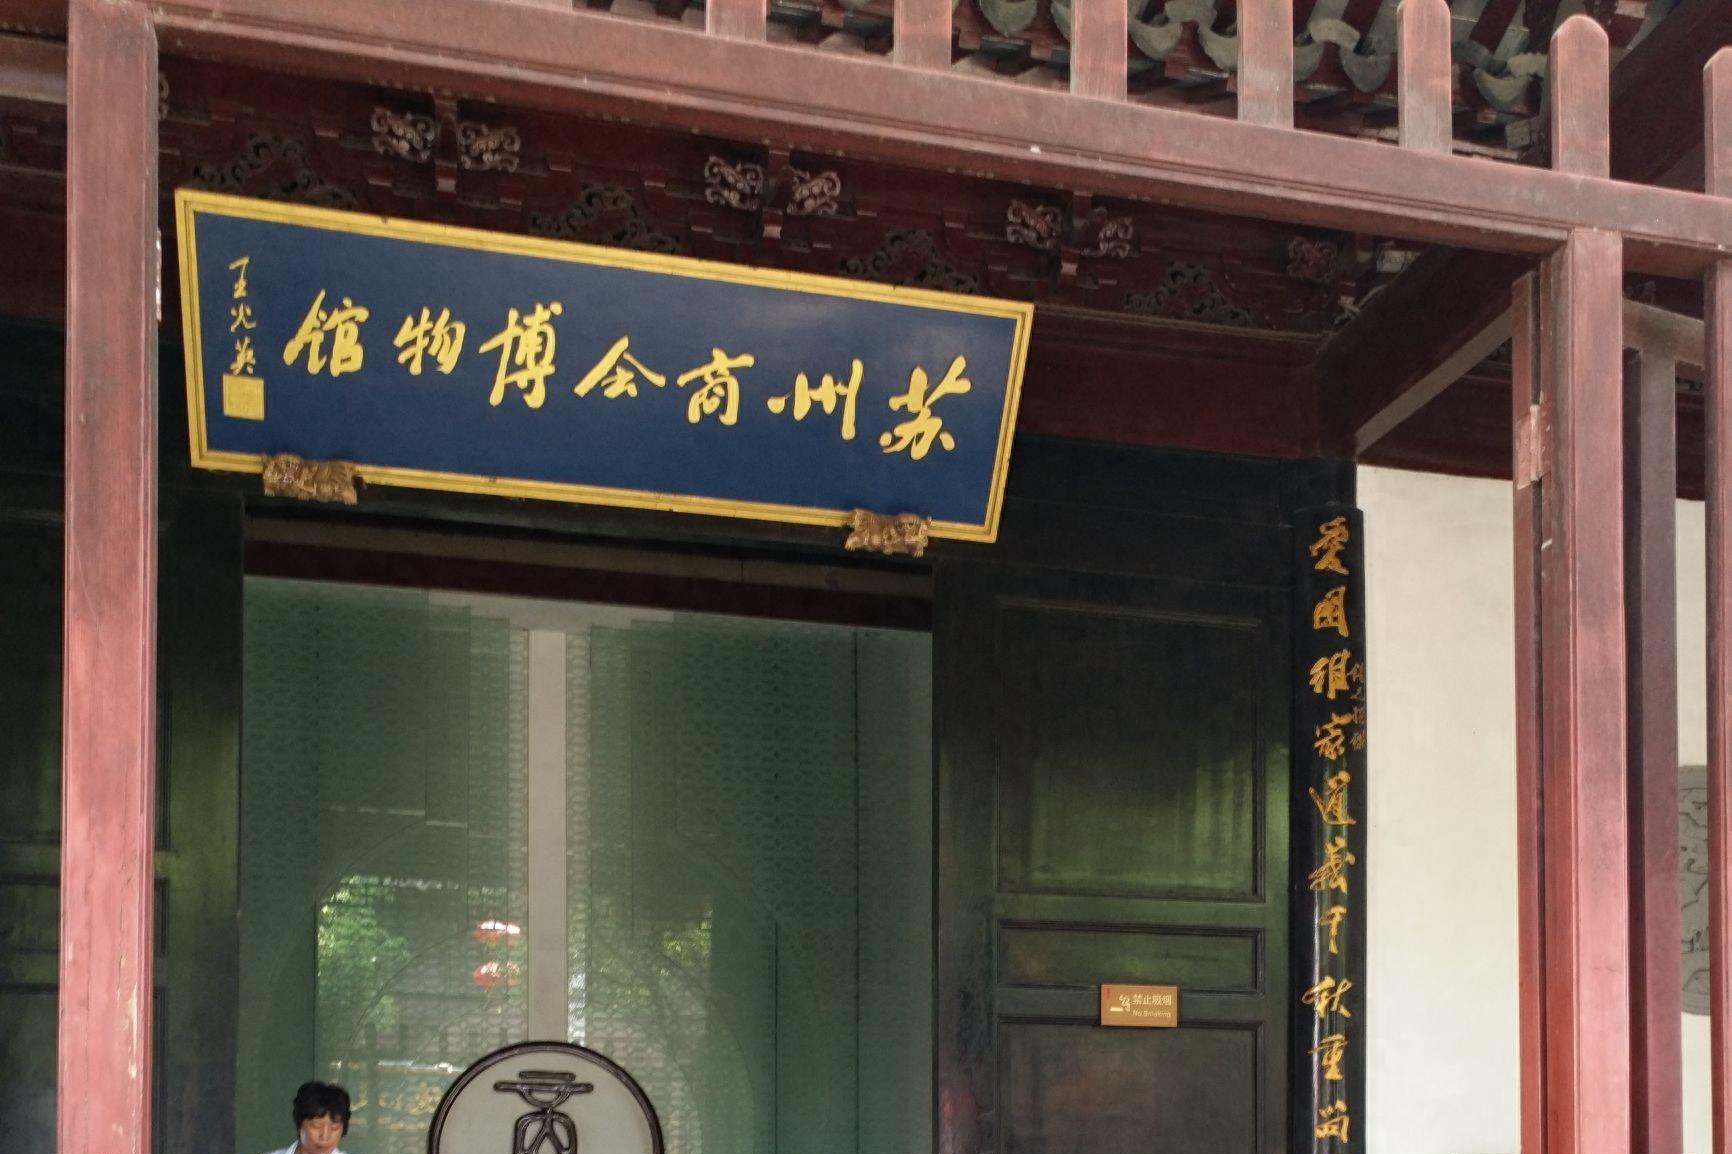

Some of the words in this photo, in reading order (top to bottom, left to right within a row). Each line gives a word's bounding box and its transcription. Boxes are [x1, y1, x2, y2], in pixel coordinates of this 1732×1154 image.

[284, 288, 972, 461] 苏州商会博物馆
[1132, 994, 1172, 1006] 禁止吸烟
